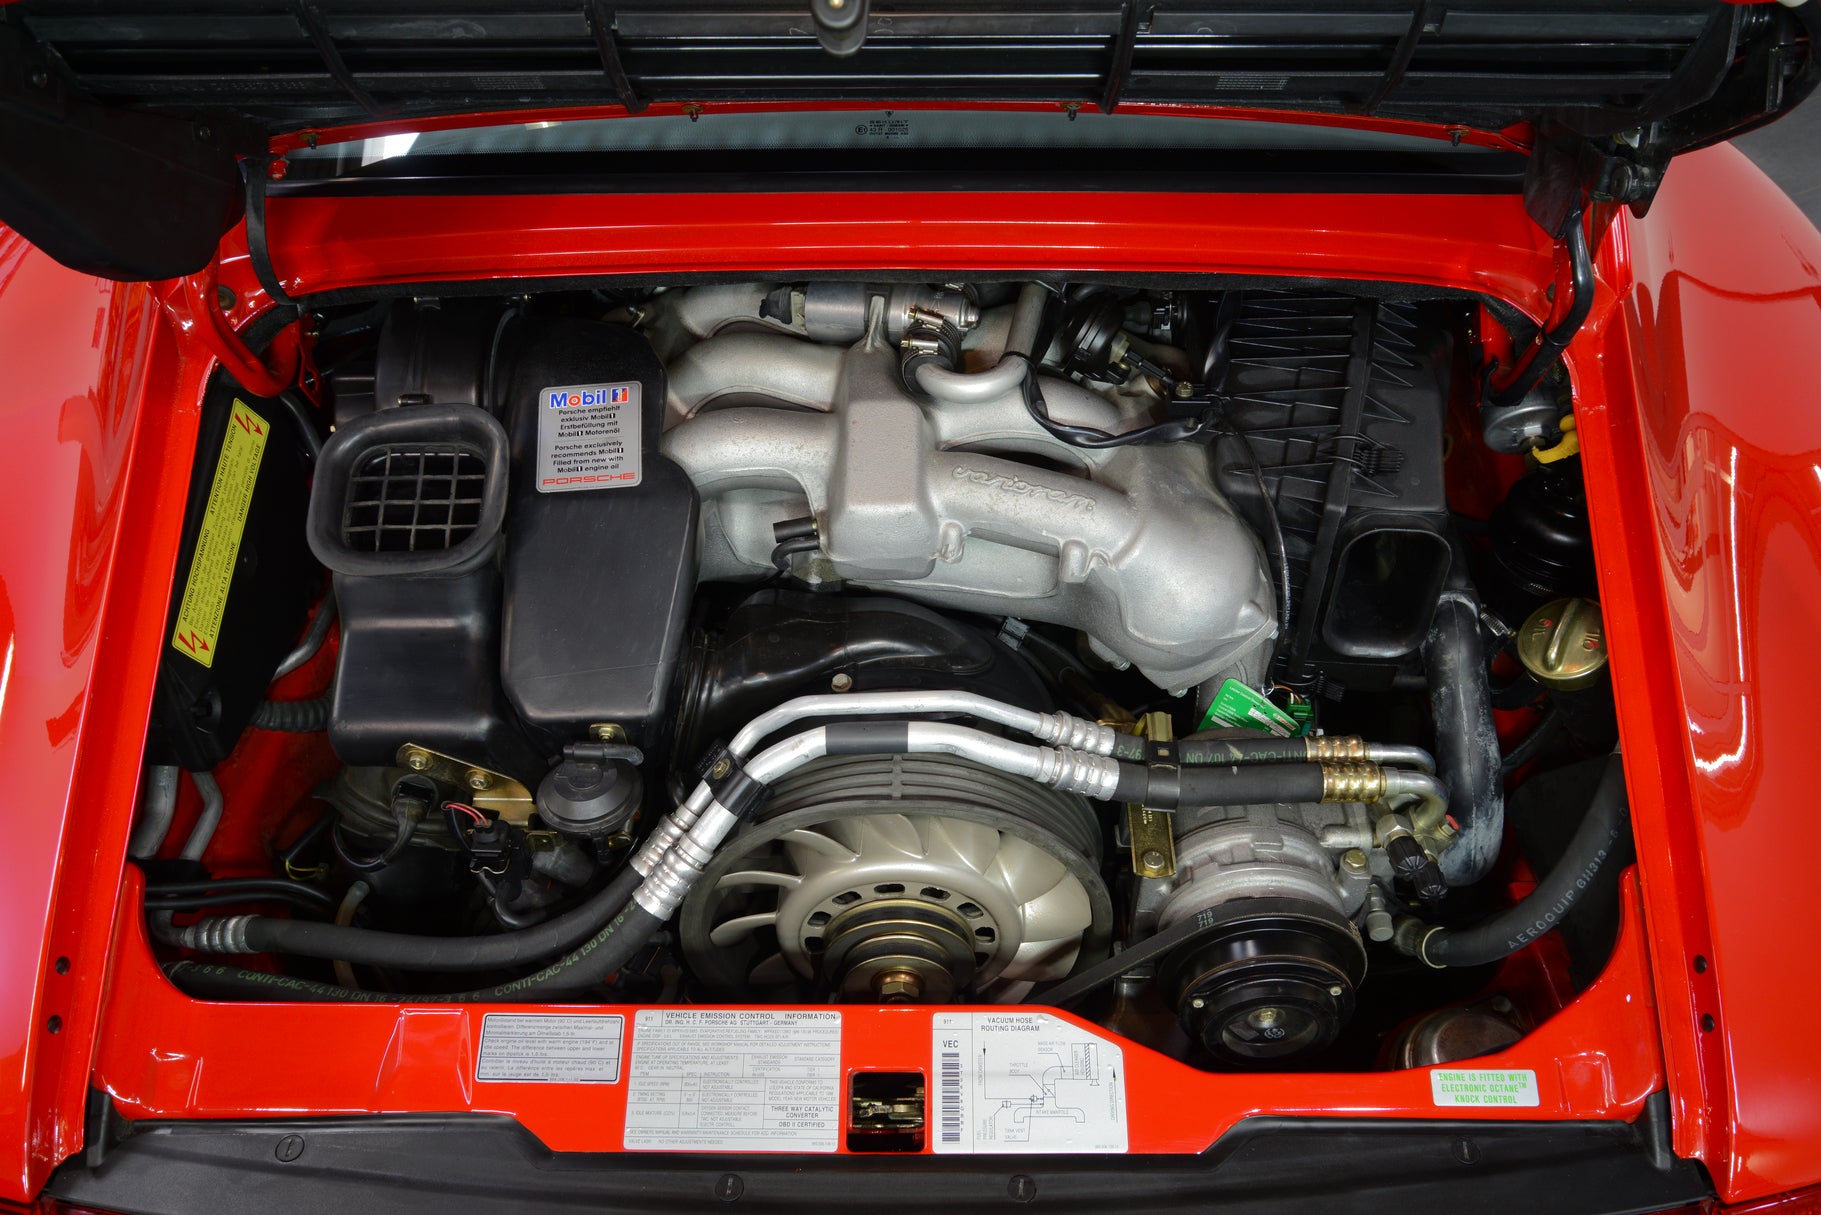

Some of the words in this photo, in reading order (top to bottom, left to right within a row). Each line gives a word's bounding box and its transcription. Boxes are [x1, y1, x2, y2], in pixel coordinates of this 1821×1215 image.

[550, 390, 606, 408] Mobil
[560, 422, 605, 430] Erstbefüllung
[584, 441, 622, 449] exclusively
[209, 476, 222, 515] ATTENTION
[219, 452, 228, 476] HAUTE
[225, 422, 236, 452] TENSION
[237, 492, 248, 522] DANGER
[244, 474, 253, 492] HIGH
[249, 442, 260, 475] VOLTAGE
[543, 472, 635, 485] PORSCHE
[182, 586, 195, 622] ACHTUNG
[191, 527, 210, 586] HOCHSPANNUNG
[208, 594, 223, 639] ATTENZIONE
[219, 574, 228, 594] ALTA
[224, 540, 236, 575] TENSIONE
[1197, 911, 1213, 921] 719
[1199, 918, 1214, 927] 719
[1508, 890, 1576, 949] AEROQUIP
[494, 952, 579, 997] CONTI-CAC-44
[581, 939, 597, 956] 130
[600, 924, 614, 942] DN
[614, 914, 624, 926] 16
[238, 970, 324, 995] CONTI-CAC-44
[943, 1040, 959, 1048] VEC
[1438, 1073, 1465, 1082] ENGINE
[1469, 1073, 1476, 1082] IS
[1479, 1073, 1505, 1082] FITTED
[1508, 1073, 1527, 1082] WITH
[1441, 1084, 1487, 1092] ELECTRONIC
[1455, 1095, 1480, 1103] KNOCK
[1484, 1095, 1517, 1103] CONTROL
